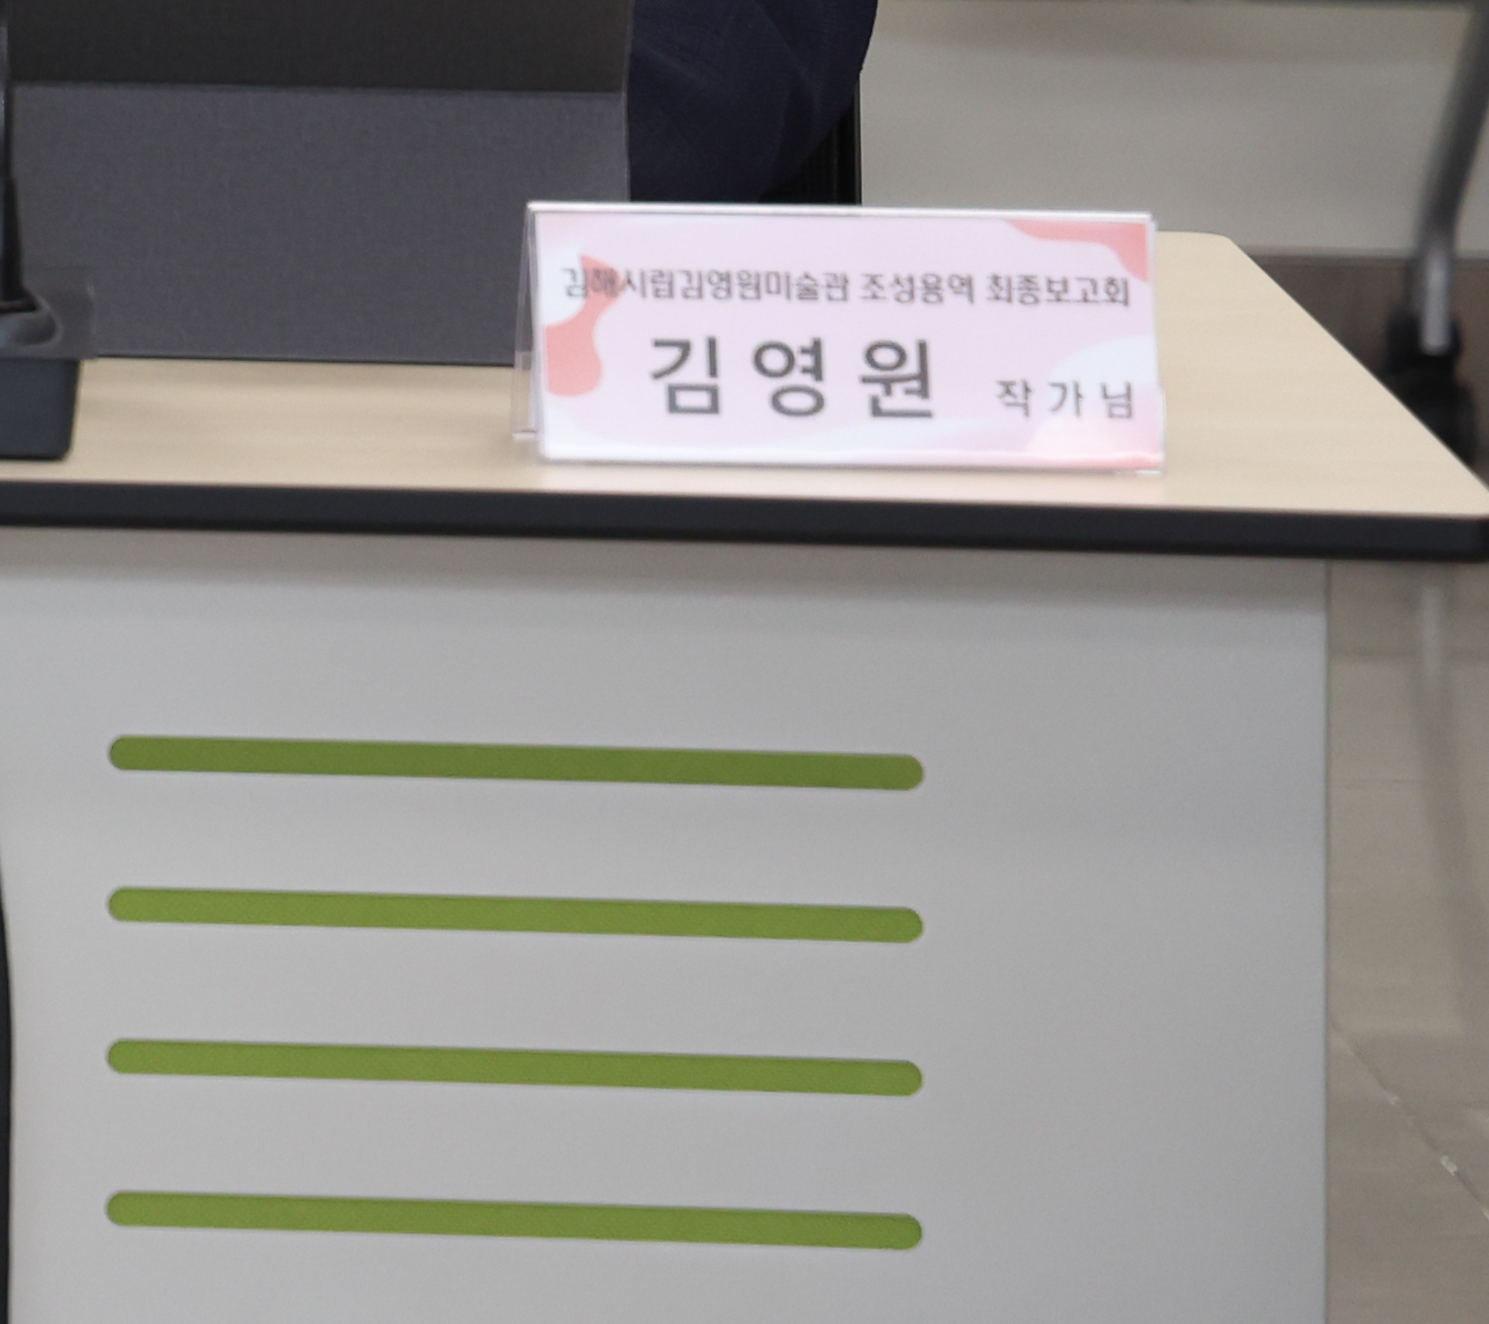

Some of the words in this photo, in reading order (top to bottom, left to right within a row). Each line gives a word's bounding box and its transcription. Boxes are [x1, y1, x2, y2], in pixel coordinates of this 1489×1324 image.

[561, 266, 850, 303] 김해시립김영원미술관
[861, 271, 976, 306] 조성용역
[985, 273, 1130, 308] 최종보고회
